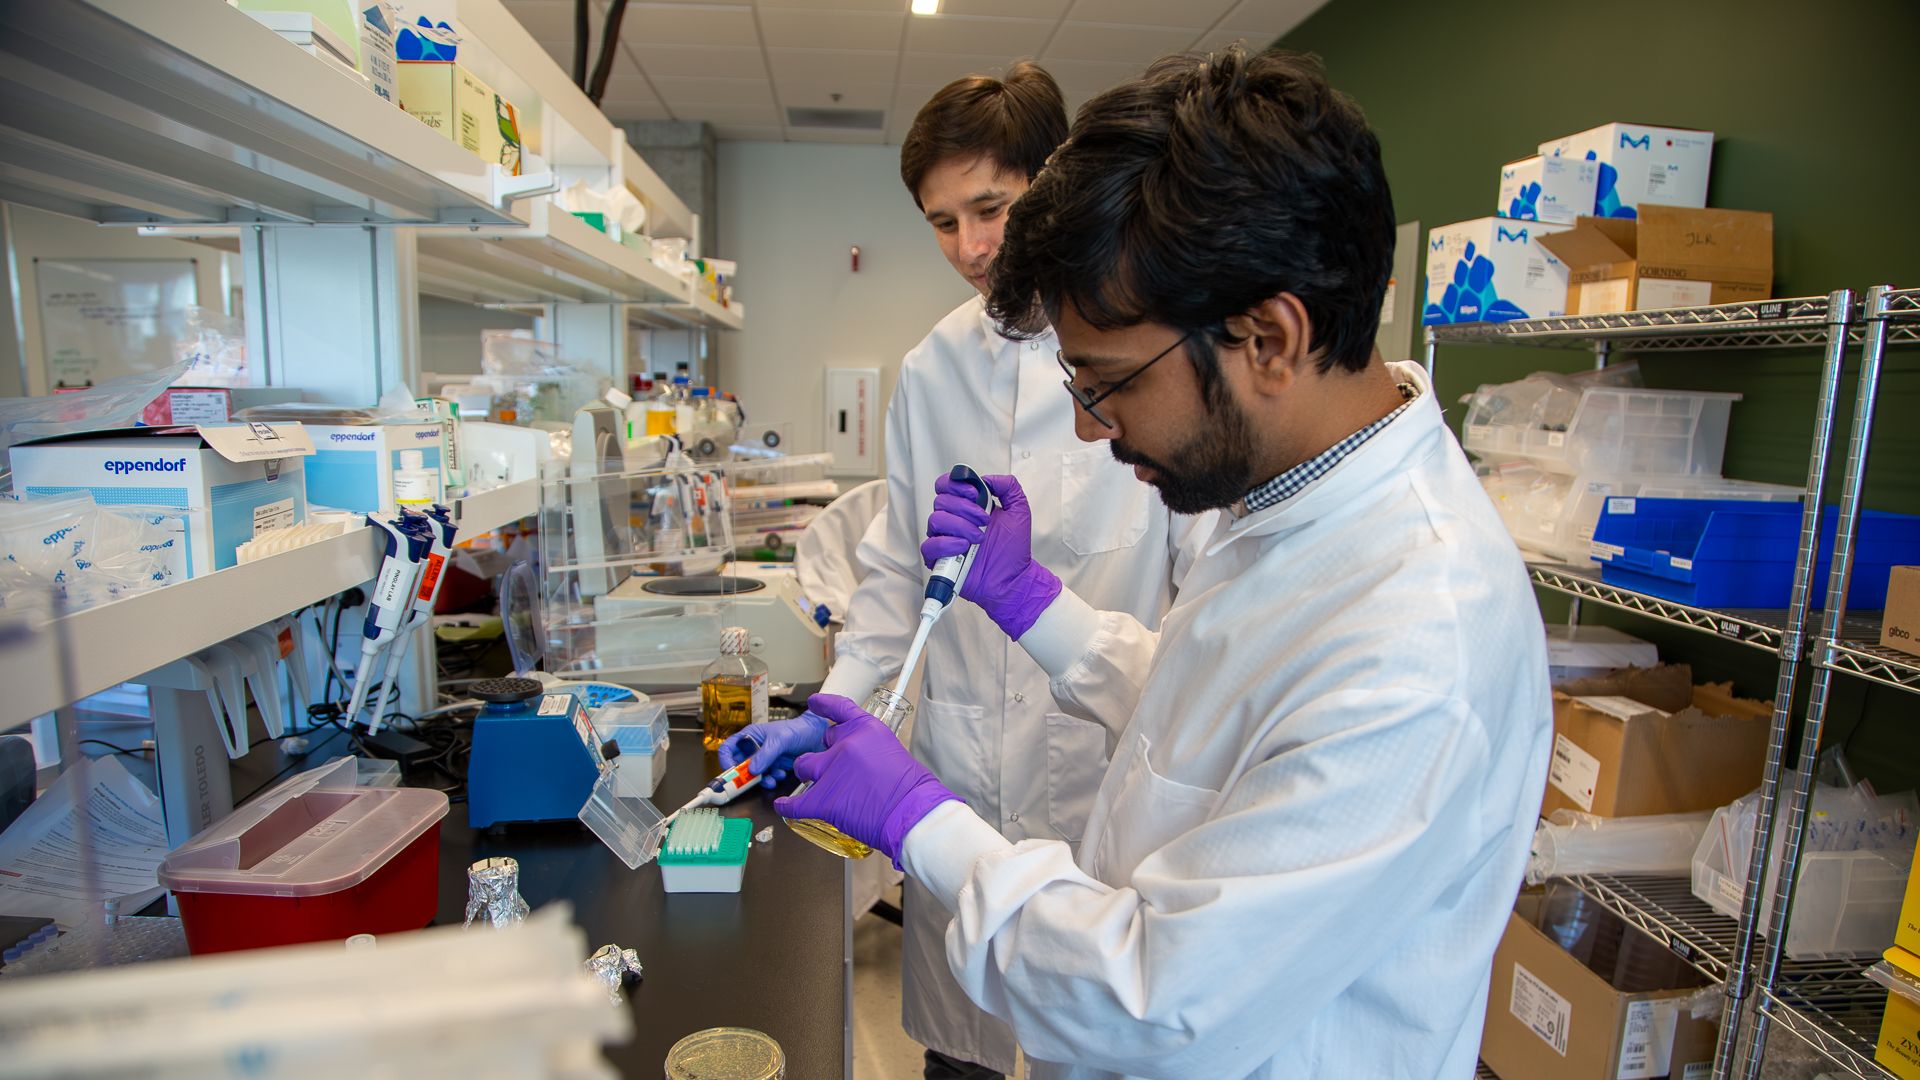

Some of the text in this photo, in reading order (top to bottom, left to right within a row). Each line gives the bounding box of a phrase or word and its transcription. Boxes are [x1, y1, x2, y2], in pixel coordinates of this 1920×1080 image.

[1639, 265, 1688, 279] CORNING
[1761, 303, 1782, 314] ULINE
[330, 431, 376, 442] eppendorf
[415, 429, 440, 440] eppendorf
[104, 458, 187, 474] eppendorf
[1721, 620, 1740, 634] ULINE
[1888, 626, 1910, 640] gibco
[195, 745, 209, 799] TOLEDO
